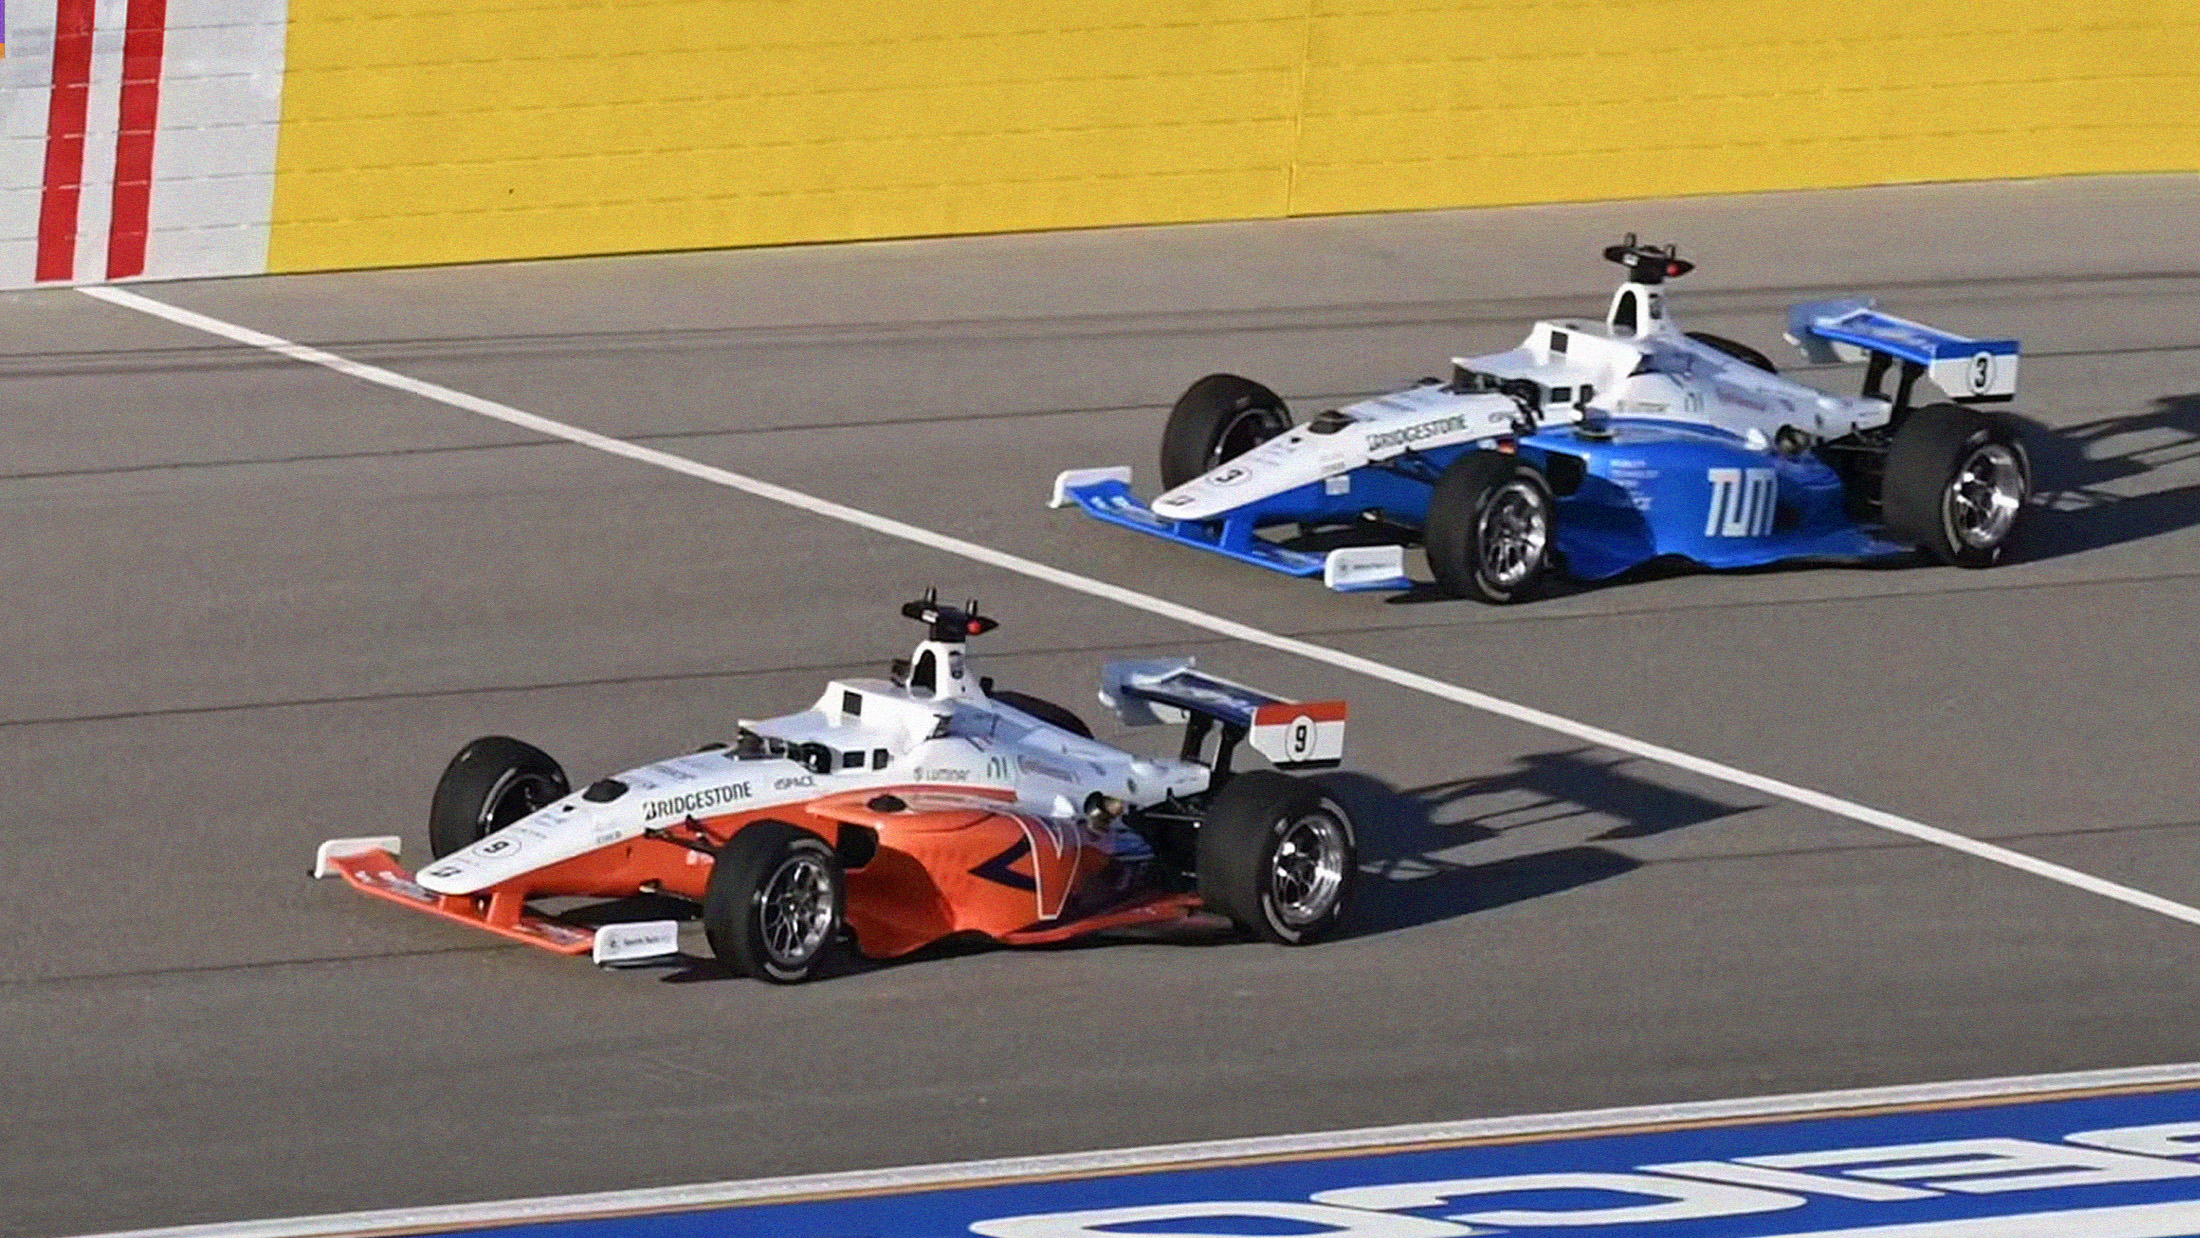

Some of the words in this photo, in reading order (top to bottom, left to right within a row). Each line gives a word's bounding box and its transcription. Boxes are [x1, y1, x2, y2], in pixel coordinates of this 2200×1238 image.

[1974, 357, 1988, 388] 3
[1366, 414, 1468, 451] BRIDGESTONE
[1215, 468, 1244, 483] 3
[1294, 724, 1308, 753] 9
[642, 781, 752, 821] BRIDGESTONE
[483, 840, 510, 854] 9
